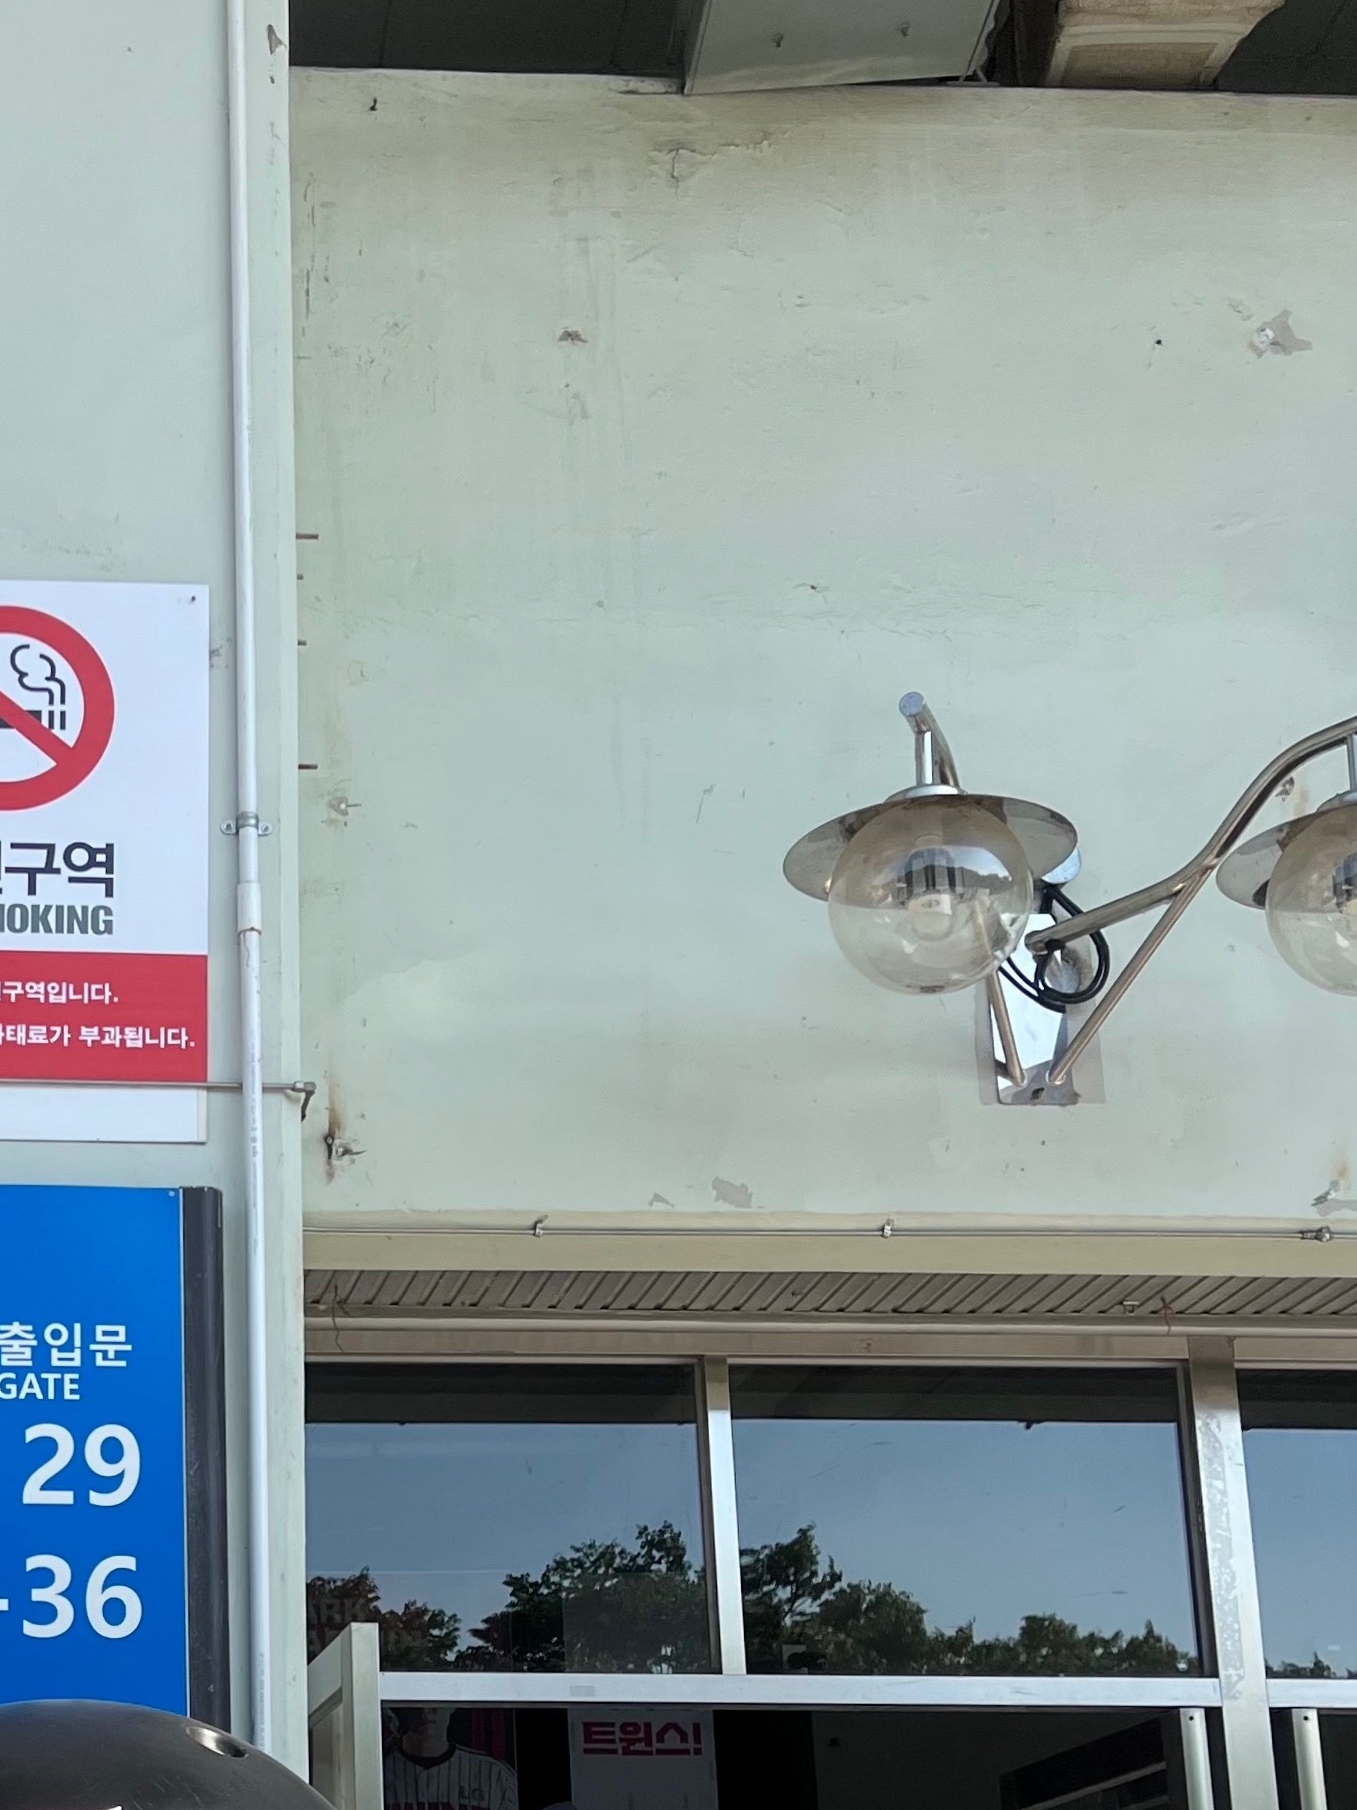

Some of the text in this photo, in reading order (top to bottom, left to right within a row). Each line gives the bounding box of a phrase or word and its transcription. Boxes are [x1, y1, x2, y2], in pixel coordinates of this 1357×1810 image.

[78, 1024, 196, 1049] 부과됩니다.
[22, 1423, 141, 1507] 29
[582, 1721, 703, 1756] 트윈스!
